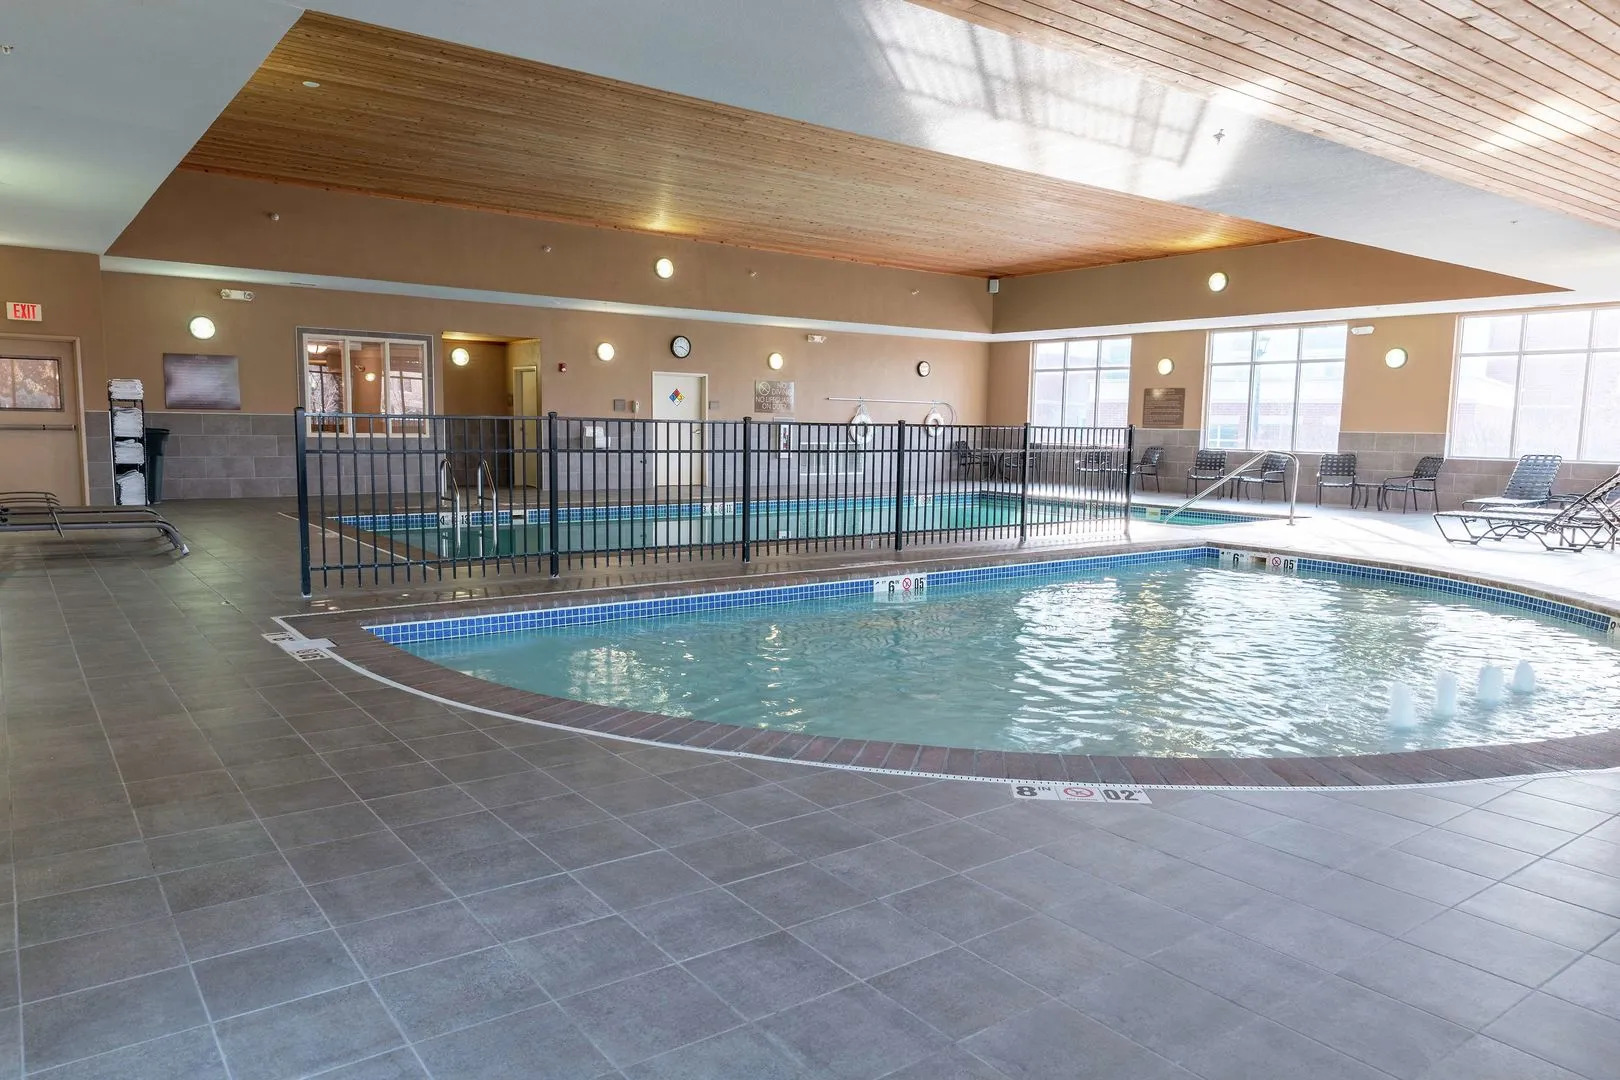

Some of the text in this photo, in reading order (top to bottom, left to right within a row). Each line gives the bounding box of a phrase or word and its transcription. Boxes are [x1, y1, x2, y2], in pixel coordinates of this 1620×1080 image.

[13, 303, 37, 320] EXIT
[771, 388, 793, 397] DIVING
[888, 580, 895, 592] 6
[1016, 785, 1038, 797] 8
